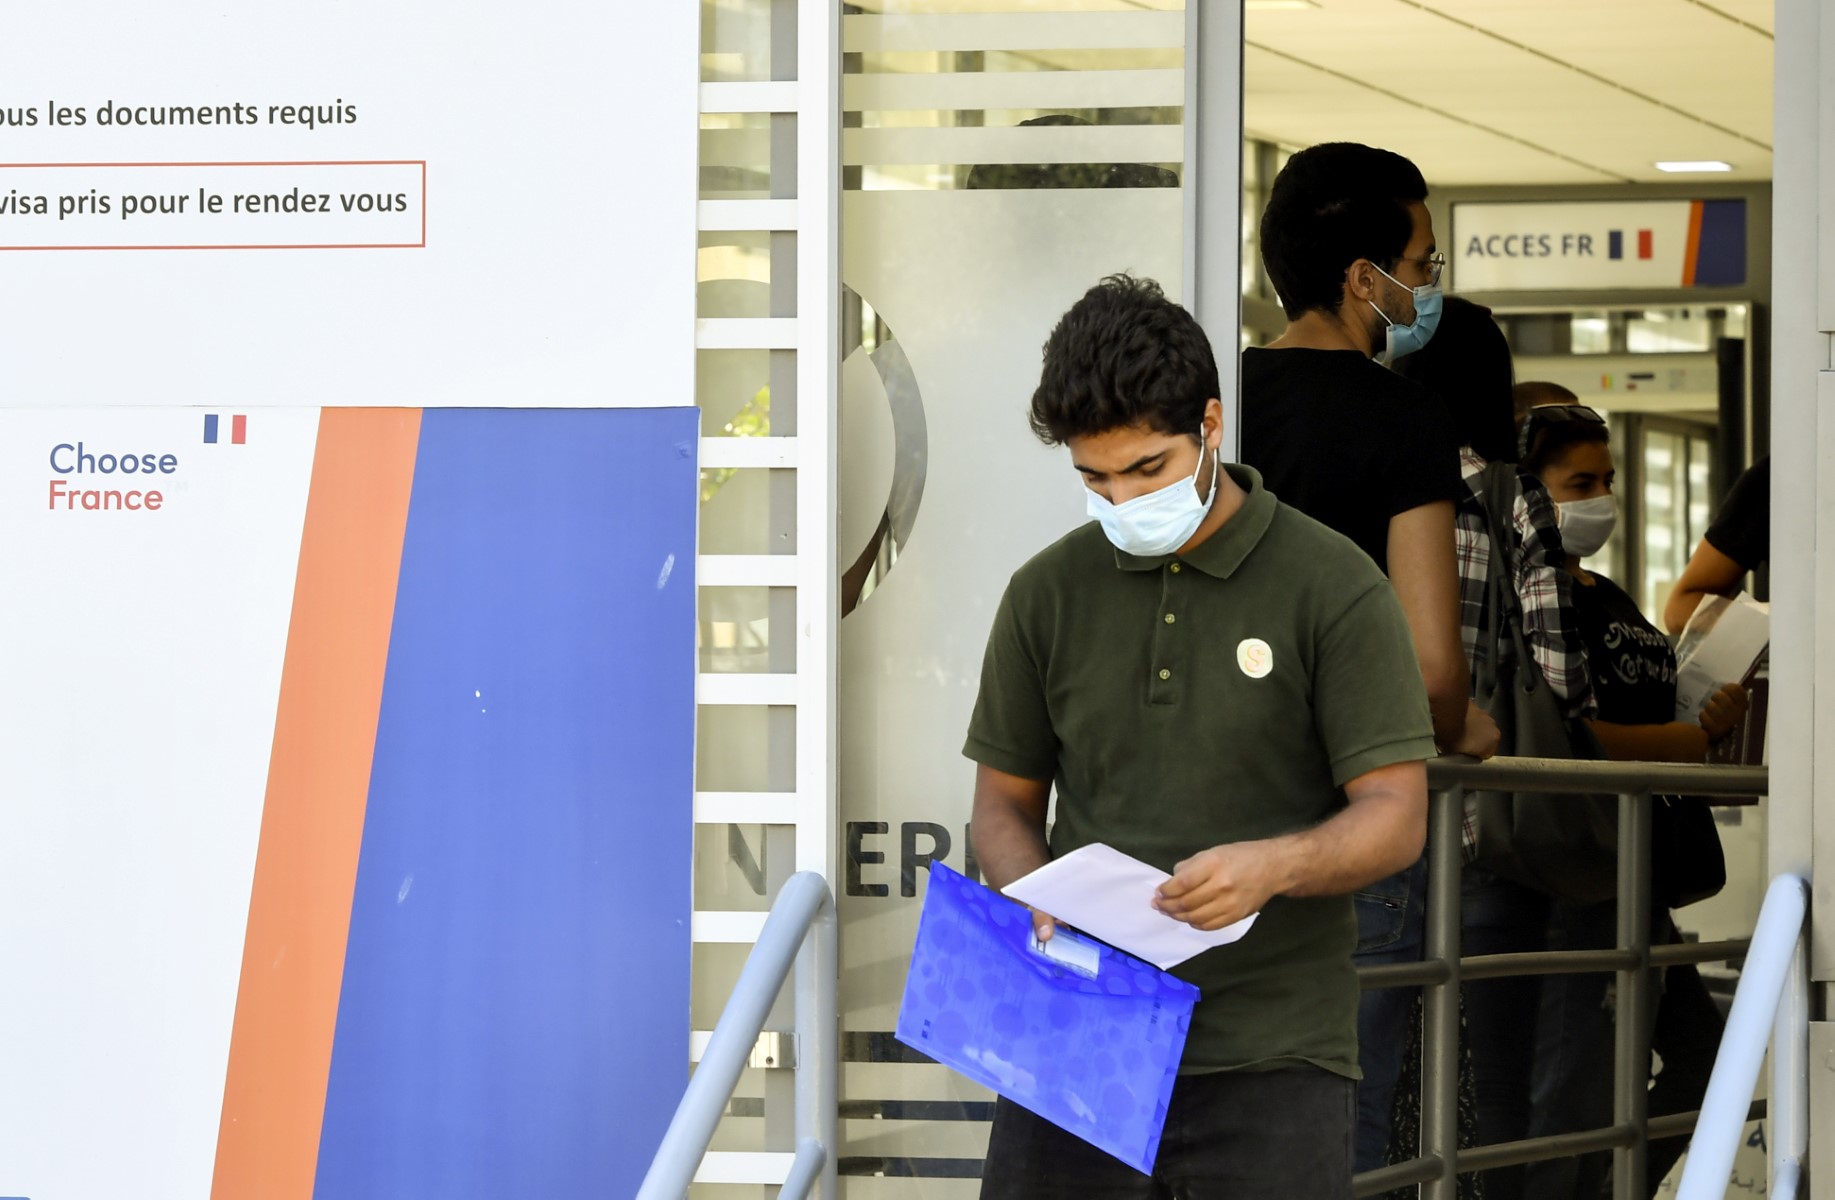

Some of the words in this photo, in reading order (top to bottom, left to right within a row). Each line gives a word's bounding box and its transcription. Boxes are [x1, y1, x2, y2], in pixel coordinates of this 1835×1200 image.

[48, 100, 87, 126] les
[96, 99, 258, 126] documents
[268, 98, 357, 130] requis
[59, 188, 111, 221] pris
[121, 194, 190, 221] pour
[199, 187, 223, 214] le
[233, 186, 331, 214] rendez
[339, 193, 407, 213] vous
[1465, 233, 1552, 258] ACCES
[1561, 232, 1595, 258] FR
[49, 441, 178, 475] Choose
[48, 479, 163, 511] France
